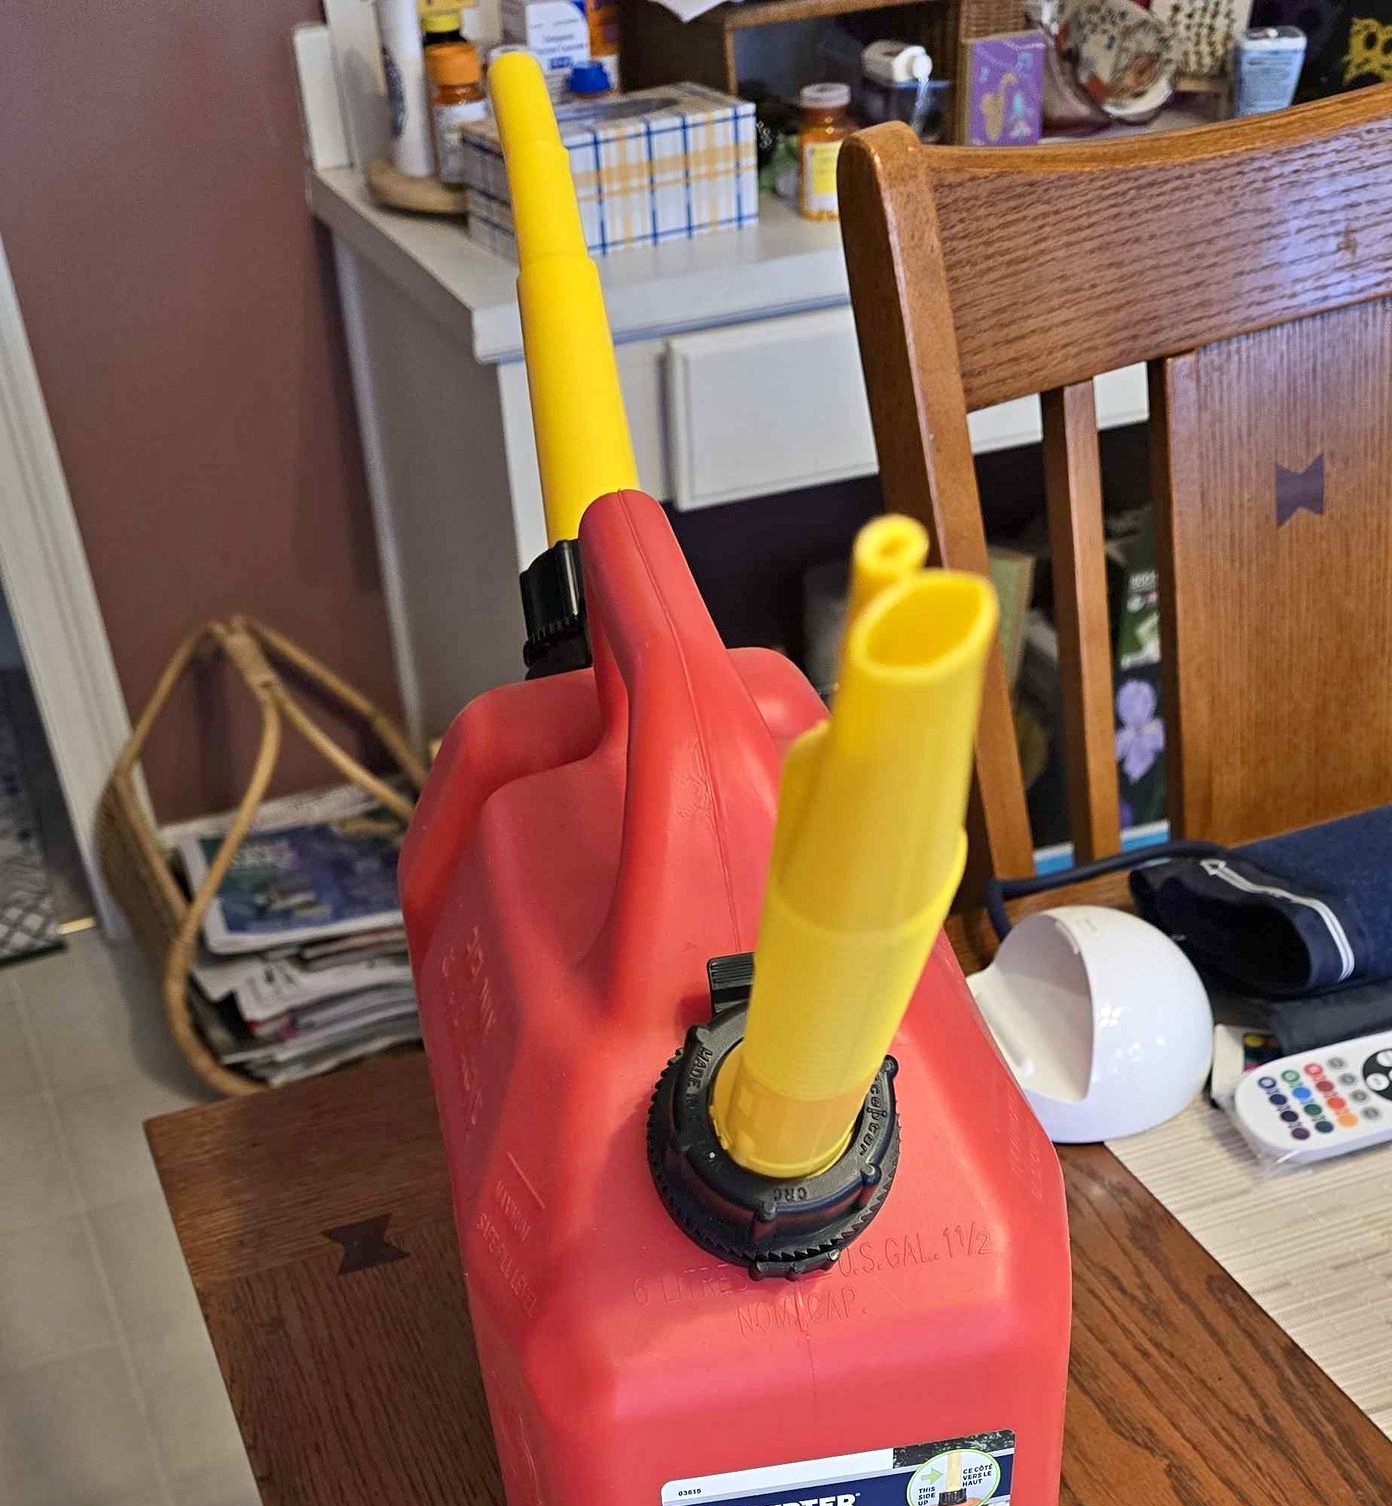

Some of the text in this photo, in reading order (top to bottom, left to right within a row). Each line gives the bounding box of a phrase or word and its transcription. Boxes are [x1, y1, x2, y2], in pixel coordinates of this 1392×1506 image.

[688, 1046, 714, 1089] MADE
[860, 1075, 888, 1156] cepter
[962, 1479, 983, 1487] HAUT
[963, 1472, 981, 1480] VERS
